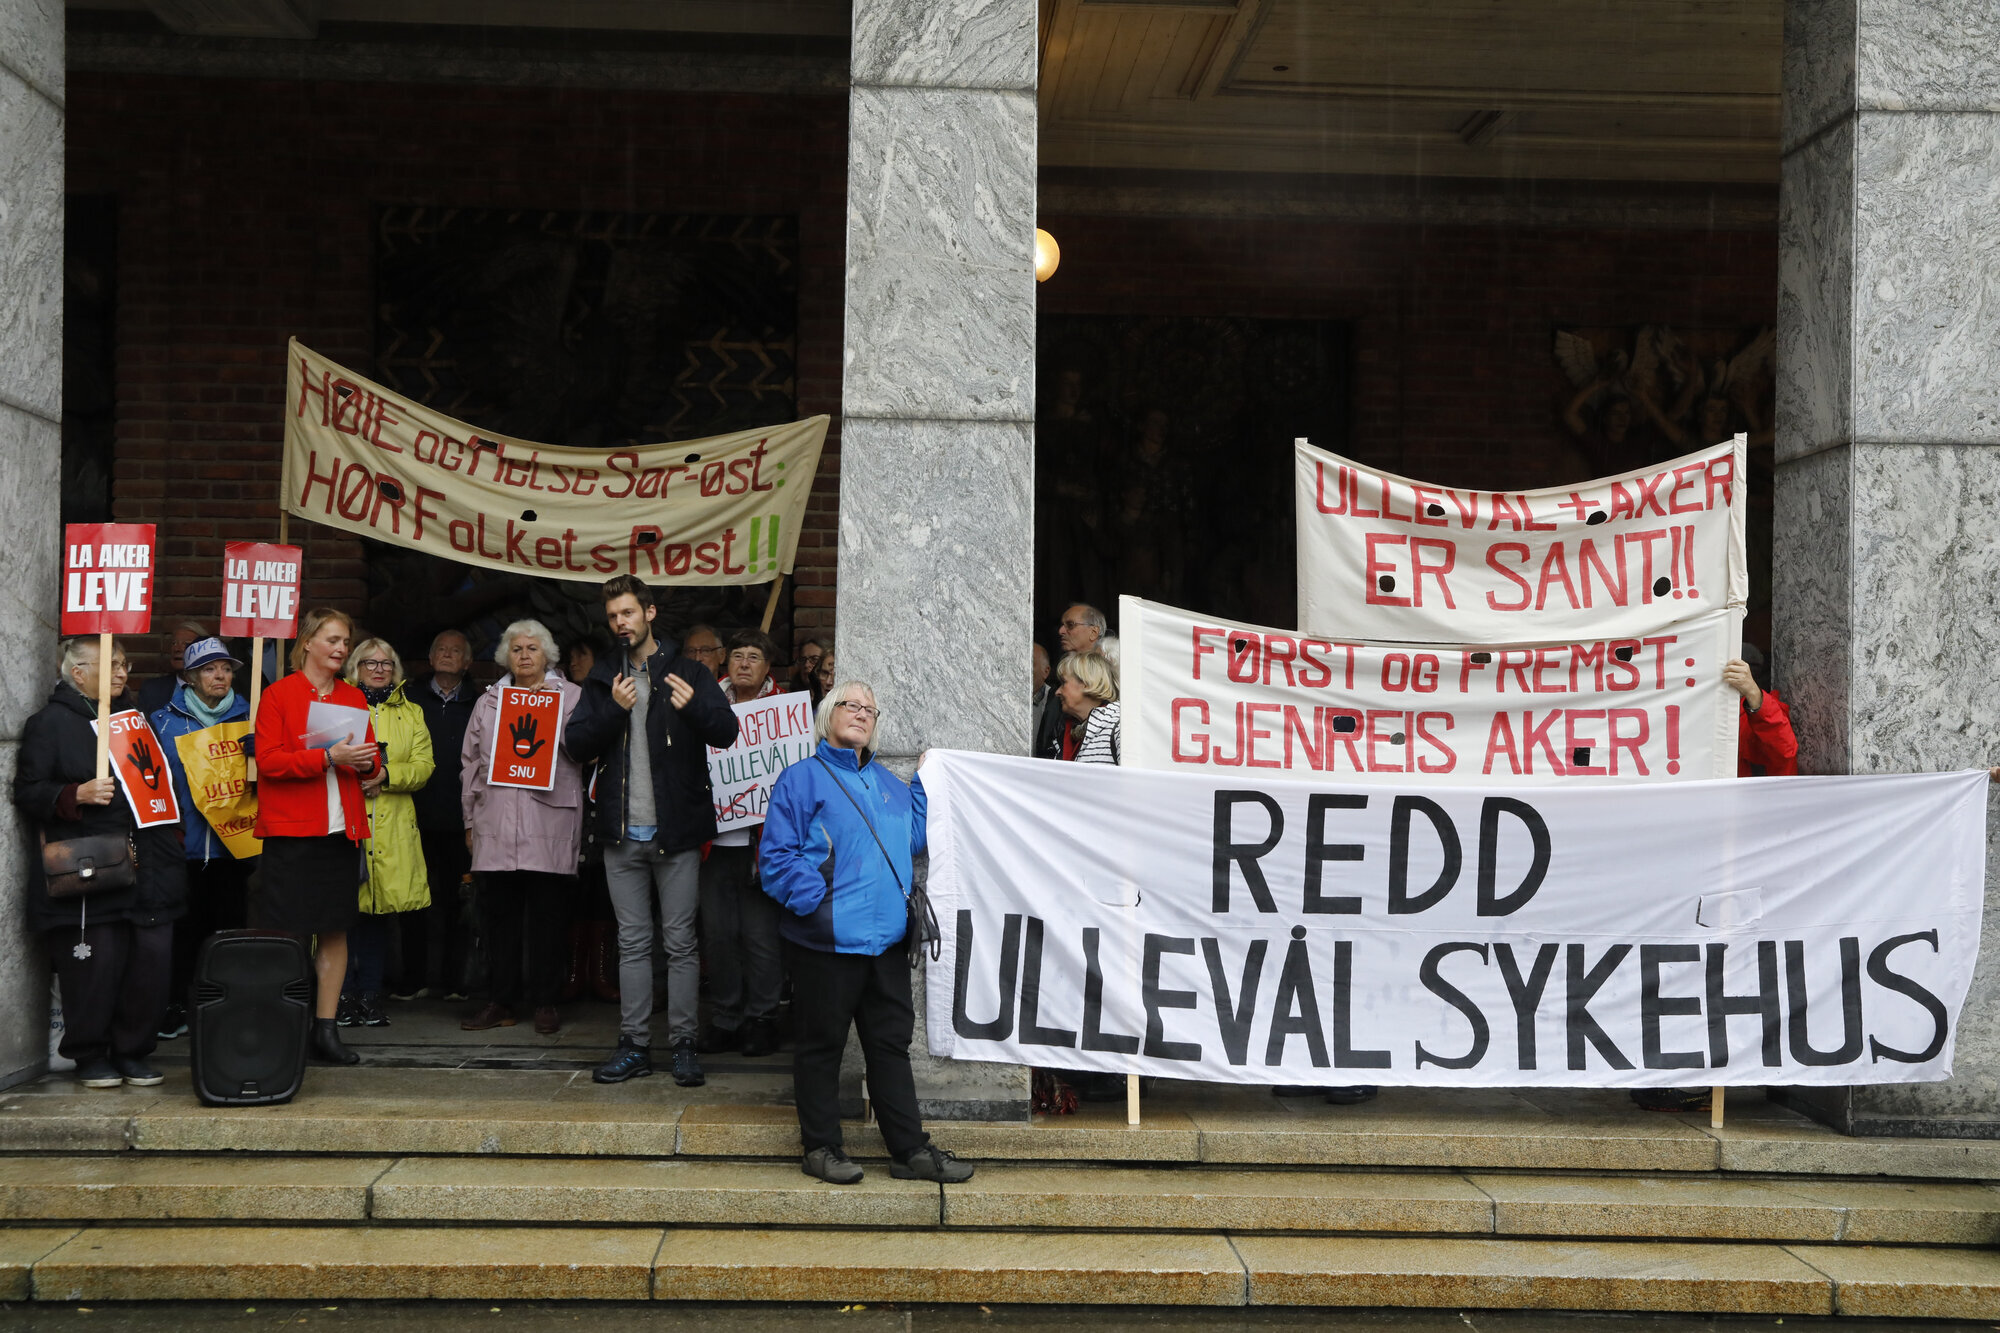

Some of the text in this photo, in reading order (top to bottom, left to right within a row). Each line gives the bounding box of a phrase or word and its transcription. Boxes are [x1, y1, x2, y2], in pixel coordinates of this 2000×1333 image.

[298, 358, 407, 453] HØIE
[1604, 454, 1735, 523] AKER
[300, 451, 406, 534] HØR
[629, 514, 780, 576] Røst!!
[69, 544, 150, 568] LA AKER
[228, 558, 297, 583] LA AKER
[1366, 525, 1699, 611] ER SANT!!
[67, 572, 149, 612] LEVE
[225, 583, 296, 620] LEVE
[1193, 626, 1697, 694] FØRST OG FREMST:
[510, 692, 553, 708] STOPP
[728, 702, 809, 750] AGFOLK!
[1172, 698, 1681, 777] GJENREIS AKER!
[208, 740, 245, 757] RED
[205, 778, 247, 799] ULLE
[508, 765, 536, 779] SNU
[150, 798, 167, 813] SNU
[716, 784, 776, 823] USTA
[1212, 789, 1552, 917] REDD
[951, 909, 1949, 1071] ULLEVÅL SYKEHUS
